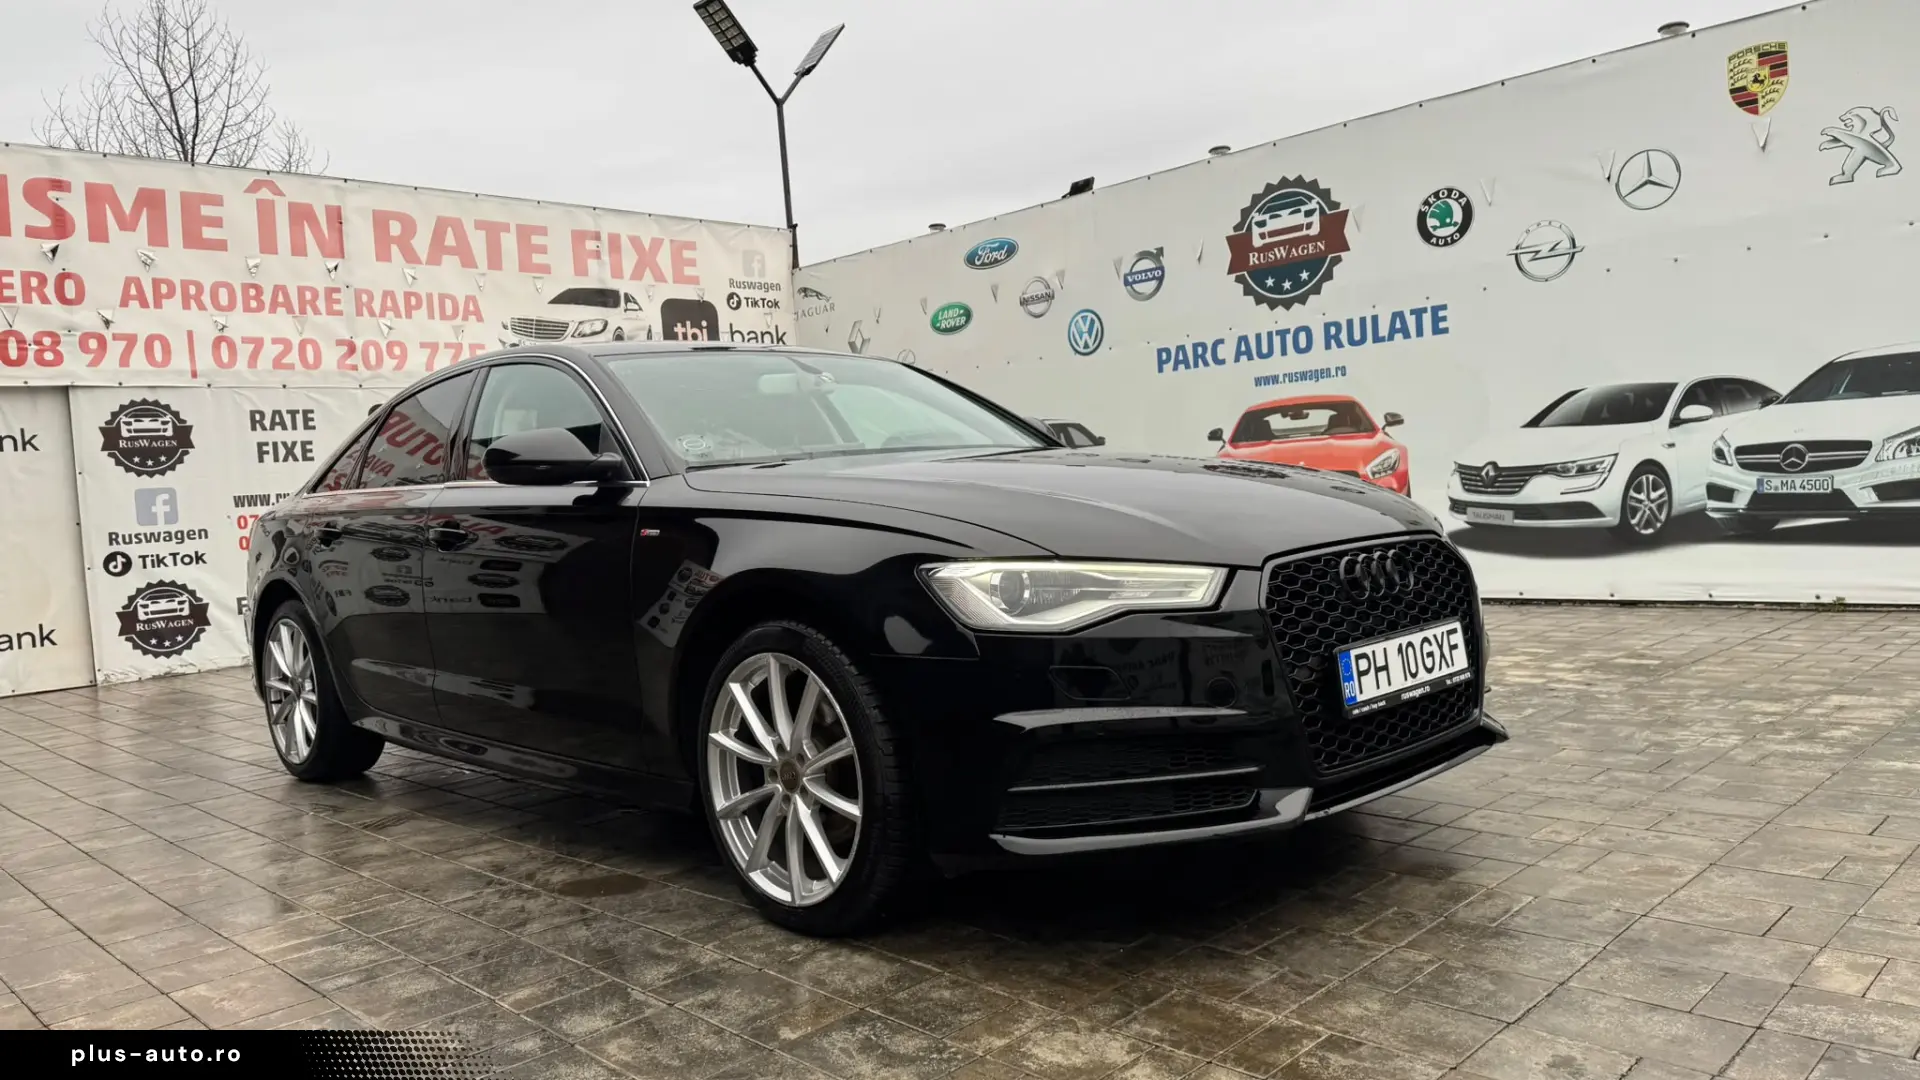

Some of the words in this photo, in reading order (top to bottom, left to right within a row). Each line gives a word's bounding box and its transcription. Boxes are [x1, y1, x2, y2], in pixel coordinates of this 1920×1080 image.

[1728, 42, 1786, 63] PORSCHE
[243, 178, 346, 260] ÎN
[372, 208, 552, 275] RATE
[570, 229, 700, 286] FIXE
[1430, 232, 1460, 245] AUTO
[974, 241, 1007, 266] Ford
[728, 277, 782, 292] Ruswagen
[1127, 269, 1162, 282] VOLVO
[119, 275, 344, 317] APROBARE
[354, 287, 485, 323] RAPIDA
[743, 297, 780, 309] TikTok
[1022, 291, 1051, 304] NISSAN
[794, 302, 835, 321] JAGUAR
[938, 307, 959, 321] LAND
[673, 320, 708, 342] tbi
[729, 322, 787, 346] bank
[940, 316, 966, 330] ROVER
[1156, 340, 1226, 374] PARC
[1232, 325, 1314, 363] AUTO
[1322, 303, 1450, 350] RULATE
[78, 331, 172, 369] 970
[212, 334, 322, 371] 0720
[335, 338, 408, 372] 209
[1254, 365, 1347, 387] www.ruswagen.ro
[249, 408, 317, 432] RATE
[256, 440, 315, 464] FIXE
[108, 526, 209, 547] Ruswagen
[138, 550, 207, 570] TikTok
[1354, 647, 1392, 695] PH
[1343, 681, 1356, 699] RO
